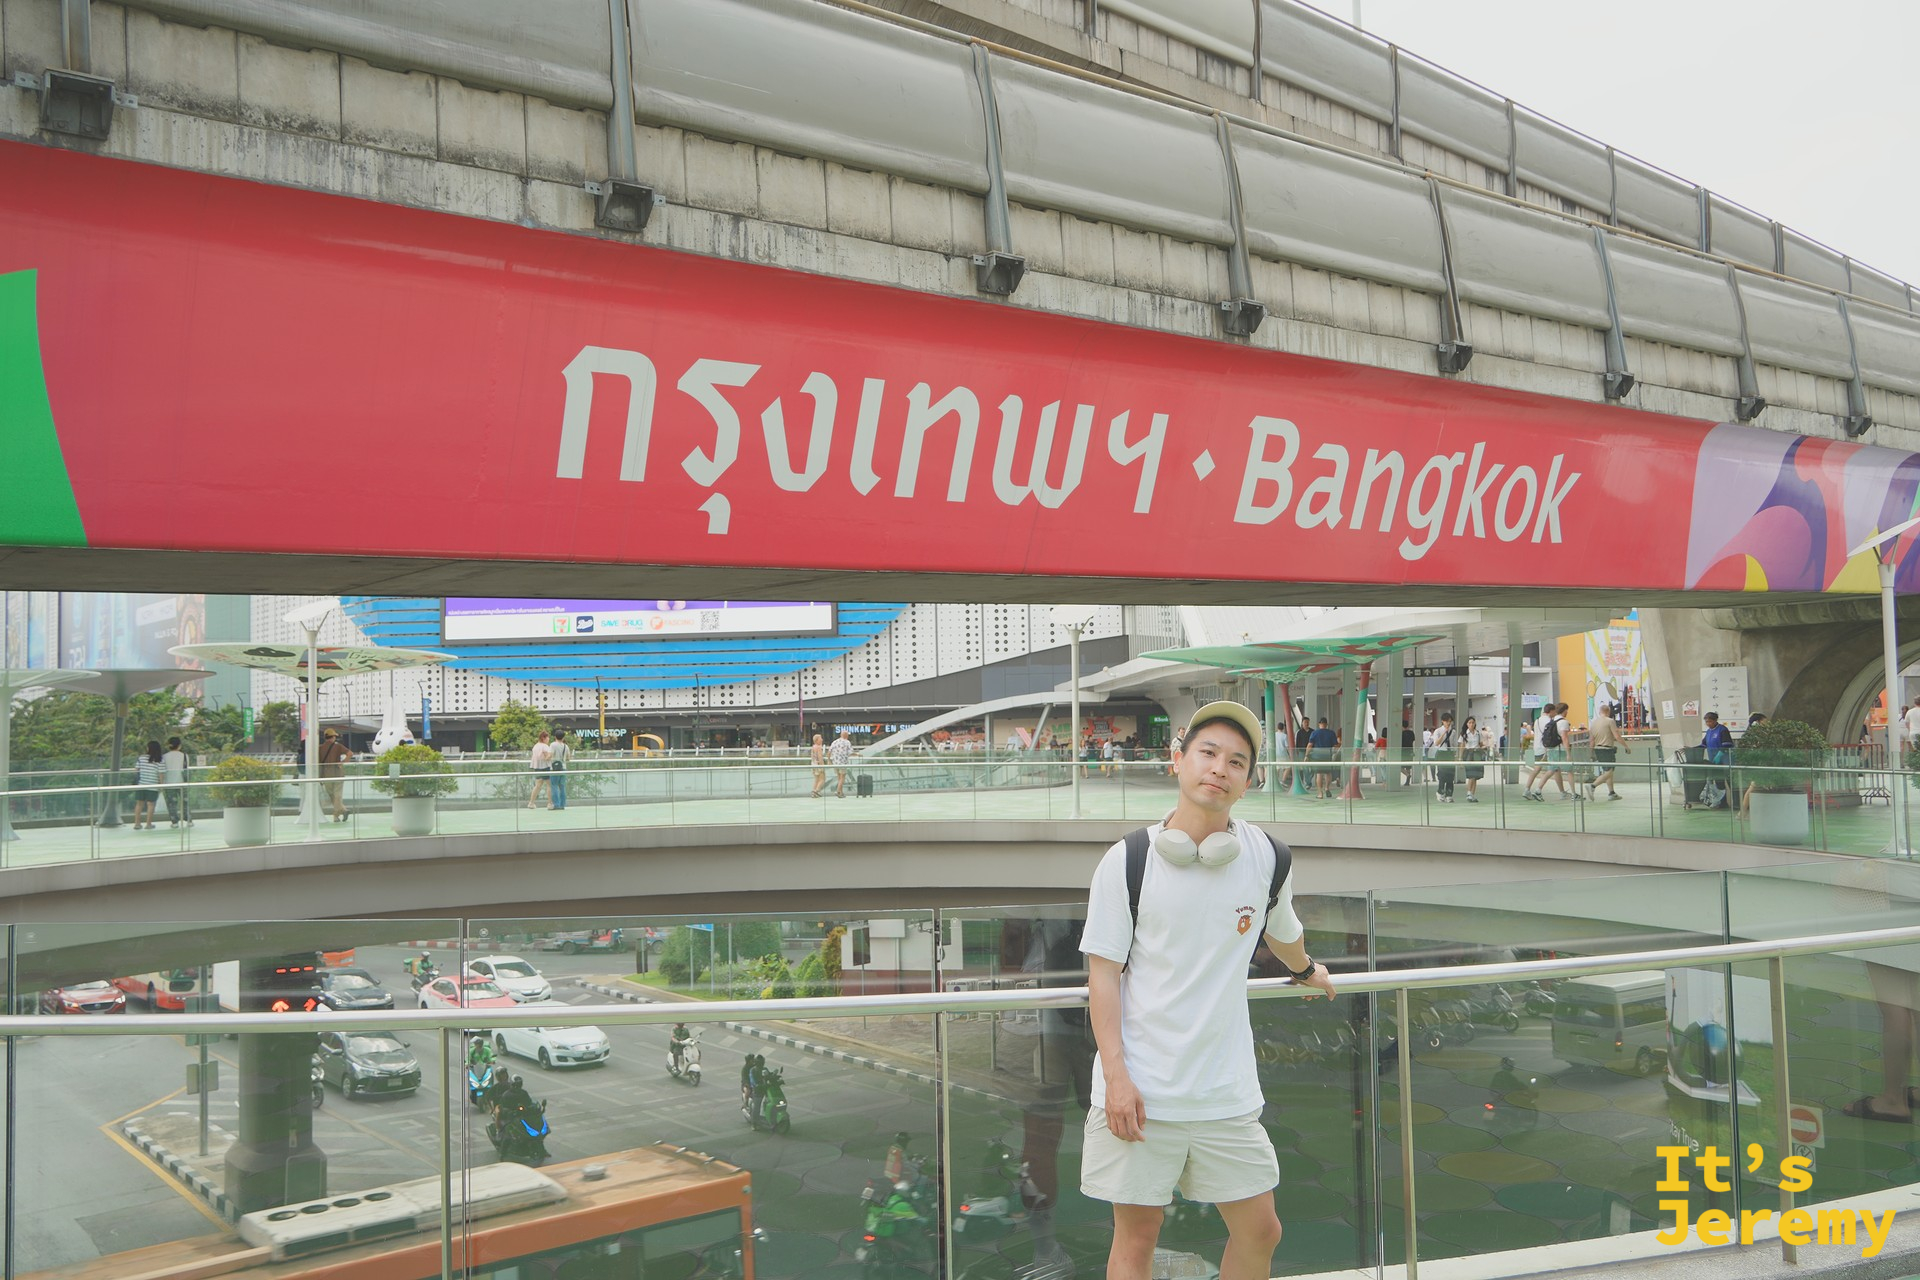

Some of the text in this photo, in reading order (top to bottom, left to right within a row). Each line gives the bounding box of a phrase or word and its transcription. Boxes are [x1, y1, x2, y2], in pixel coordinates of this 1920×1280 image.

[555, 344, 1170, 535] กรุงเทพฯ
[1232, 414, 1582, 561] Bangkok
